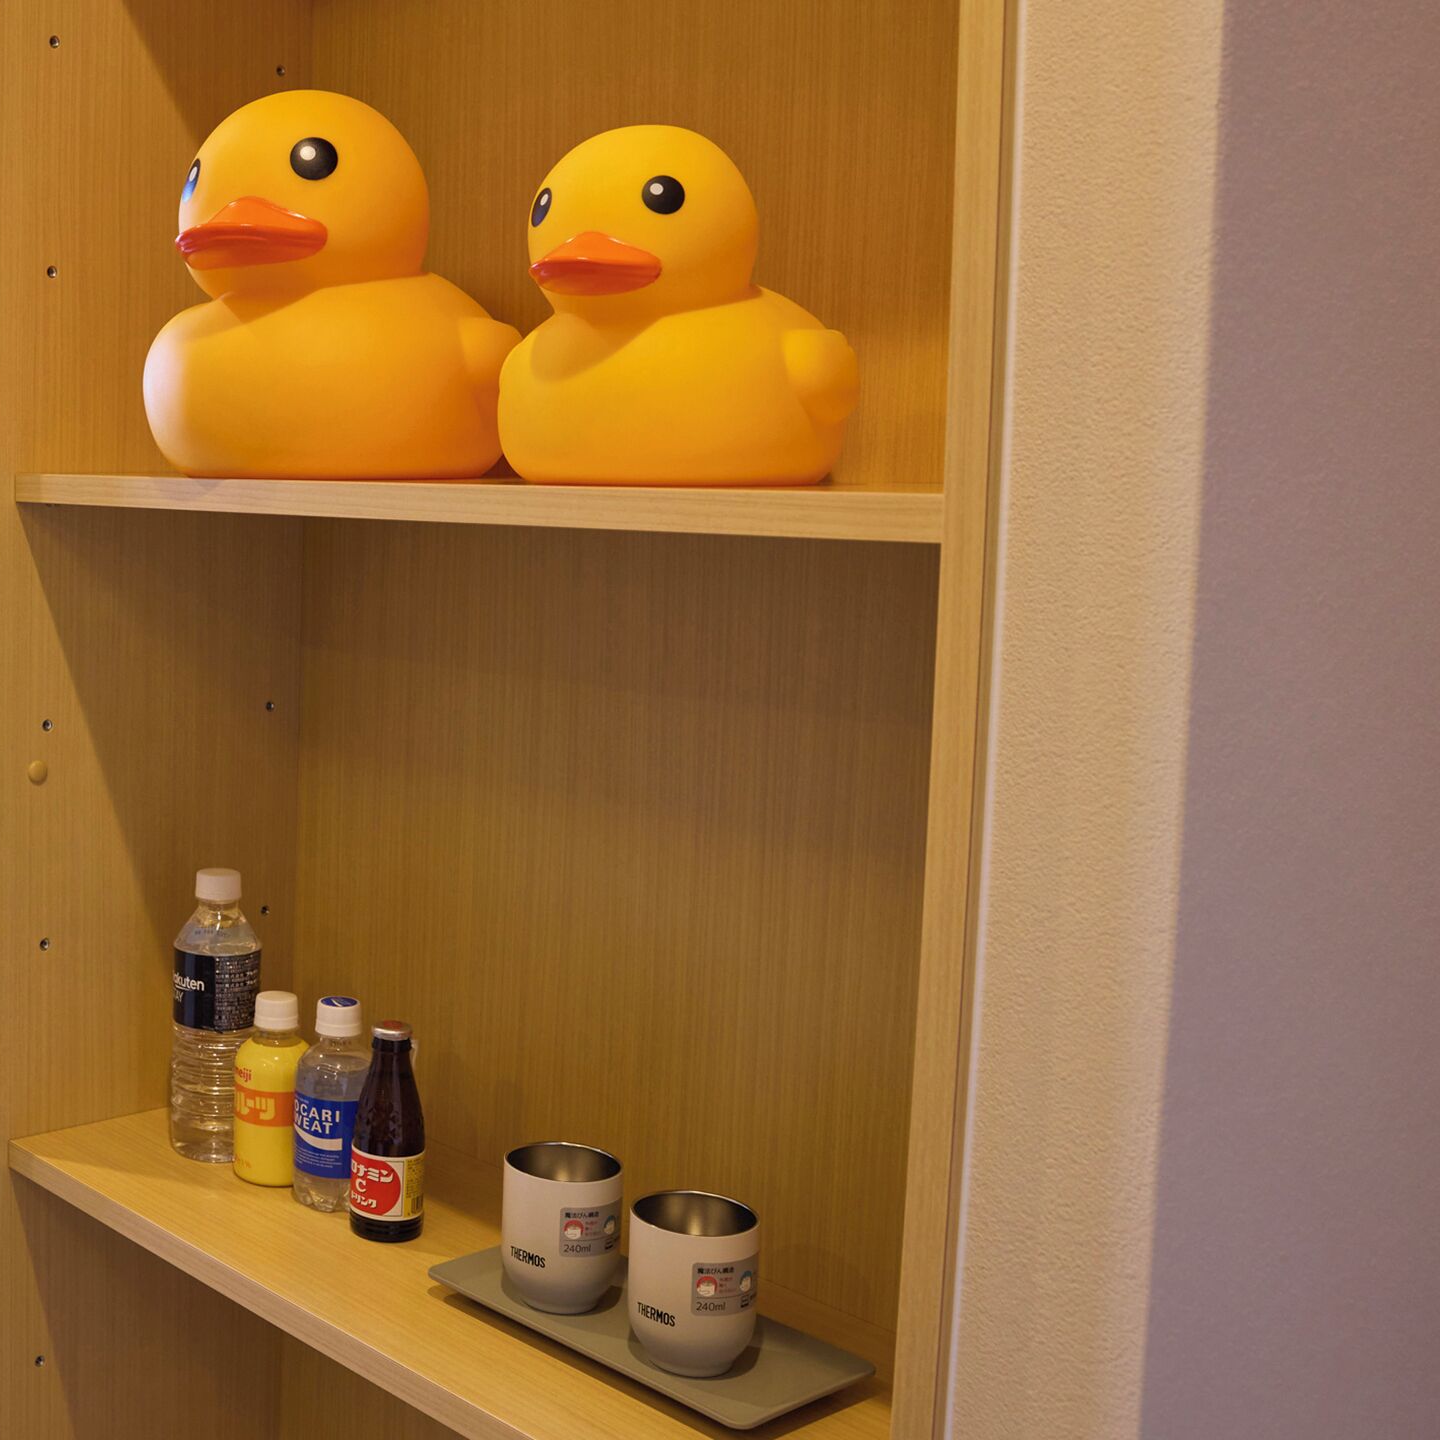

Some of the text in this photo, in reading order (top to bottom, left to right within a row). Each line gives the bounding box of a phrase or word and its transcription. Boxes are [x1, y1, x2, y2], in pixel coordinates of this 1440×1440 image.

[173, 971, 205, 992] akuten
[355, 1178, 367, 1193] C
[510, 1246, 546, 1268] THERMOS
[563, 1244, 592, 1253] 240ml
[637, 1301, 676, 1327] THERMOS
[696, 1301, 726, 1311] 240ml
